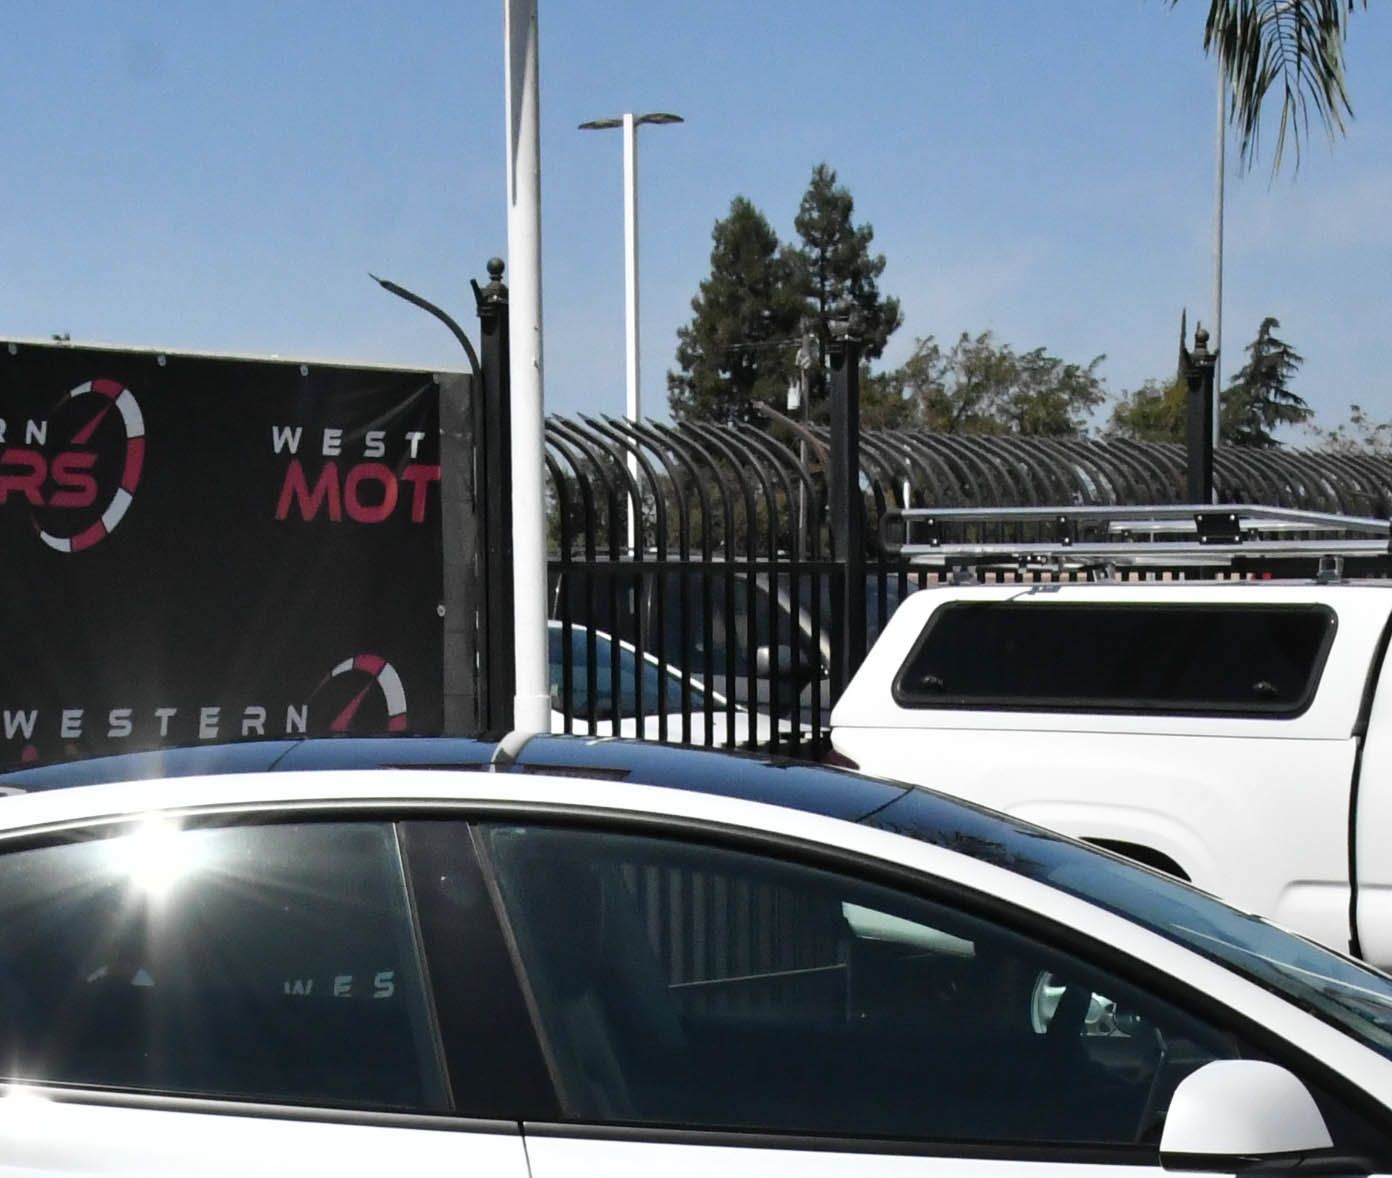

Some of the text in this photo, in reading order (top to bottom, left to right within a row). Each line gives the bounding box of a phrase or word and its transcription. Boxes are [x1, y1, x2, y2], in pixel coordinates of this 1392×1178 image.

[272, 425, 426, 459] WEST
[275, 460, 442, 523] MOT
[3, 704, 309, 740] WESTERN
